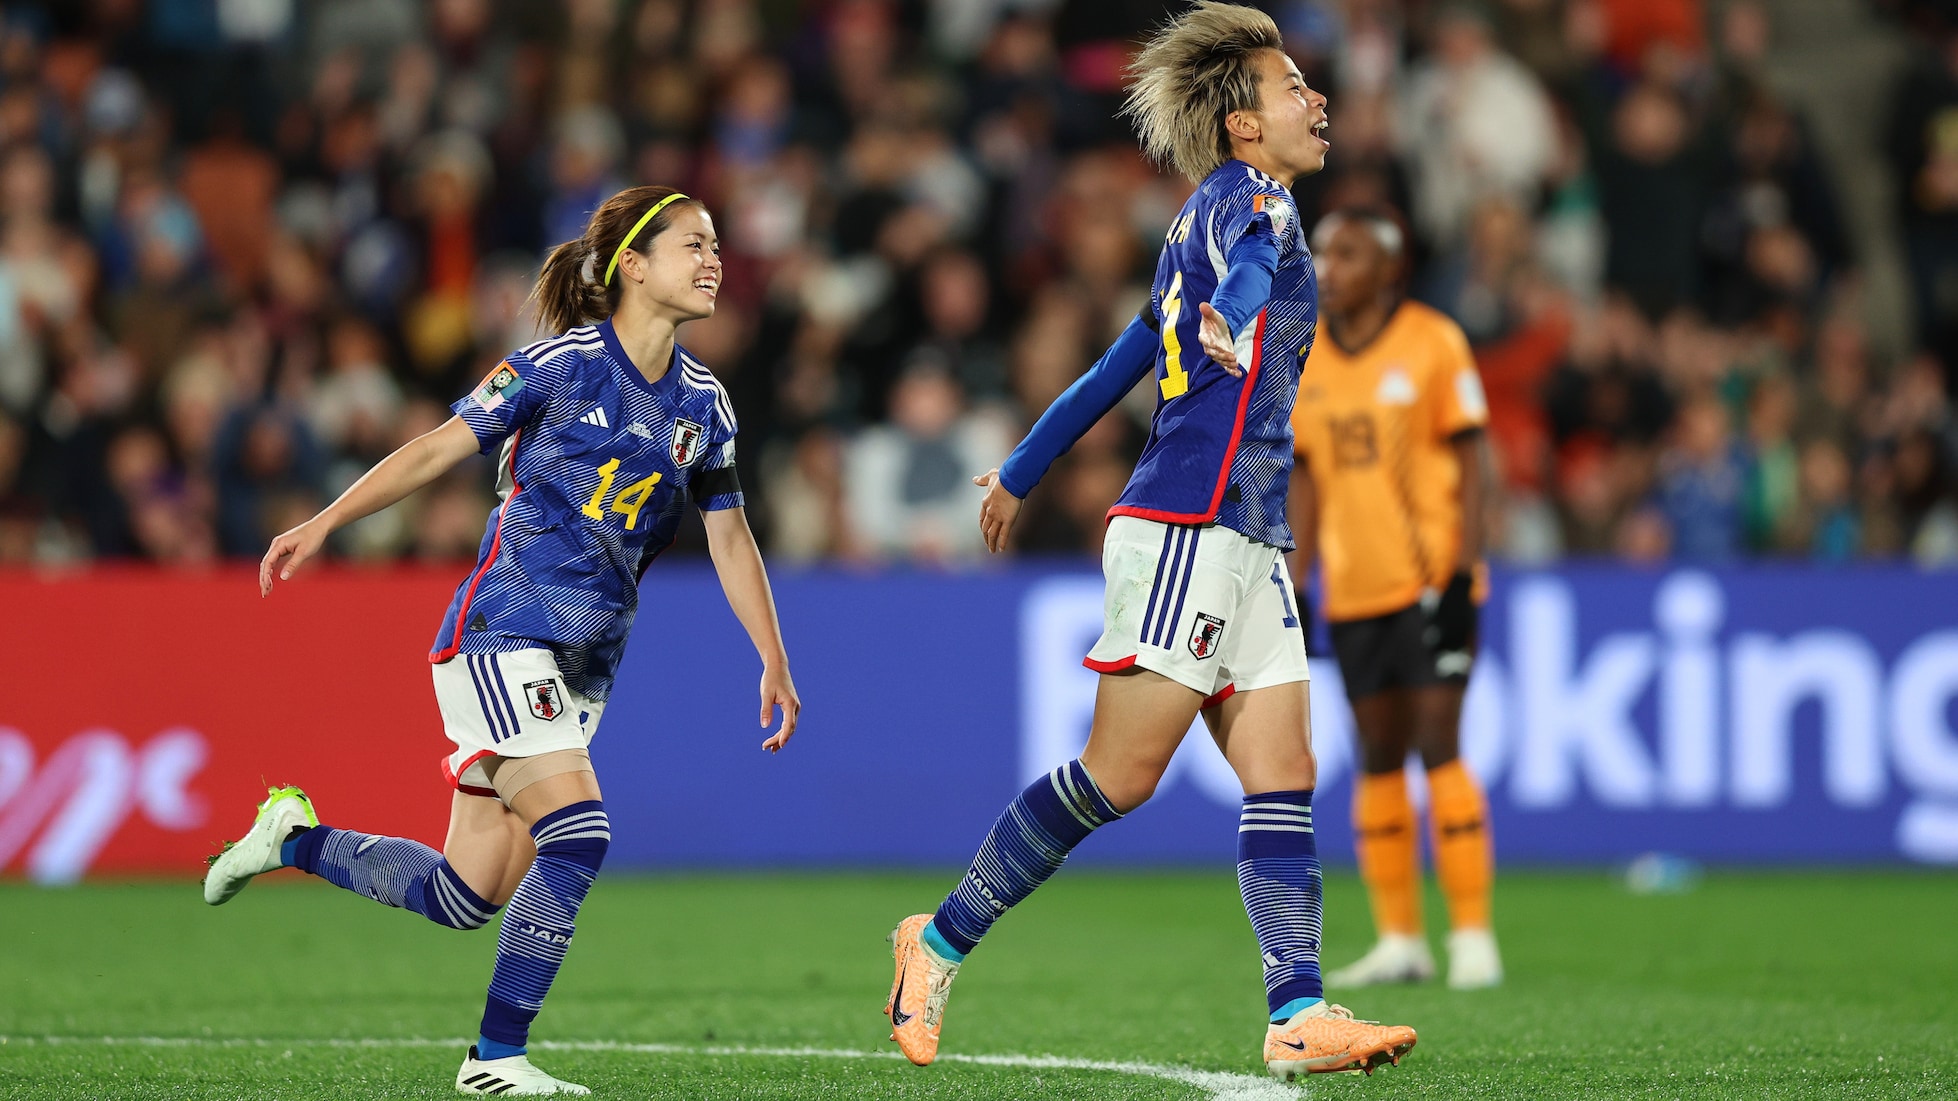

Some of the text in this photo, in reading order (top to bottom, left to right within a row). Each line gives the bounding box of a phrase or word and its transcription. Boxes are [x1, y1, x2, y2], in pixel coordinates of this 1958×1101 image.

[581, 457, 663, 531] 14
[531, 679, 550, 688] JAPAN
[1020, 572, 1958, 863] Bking
